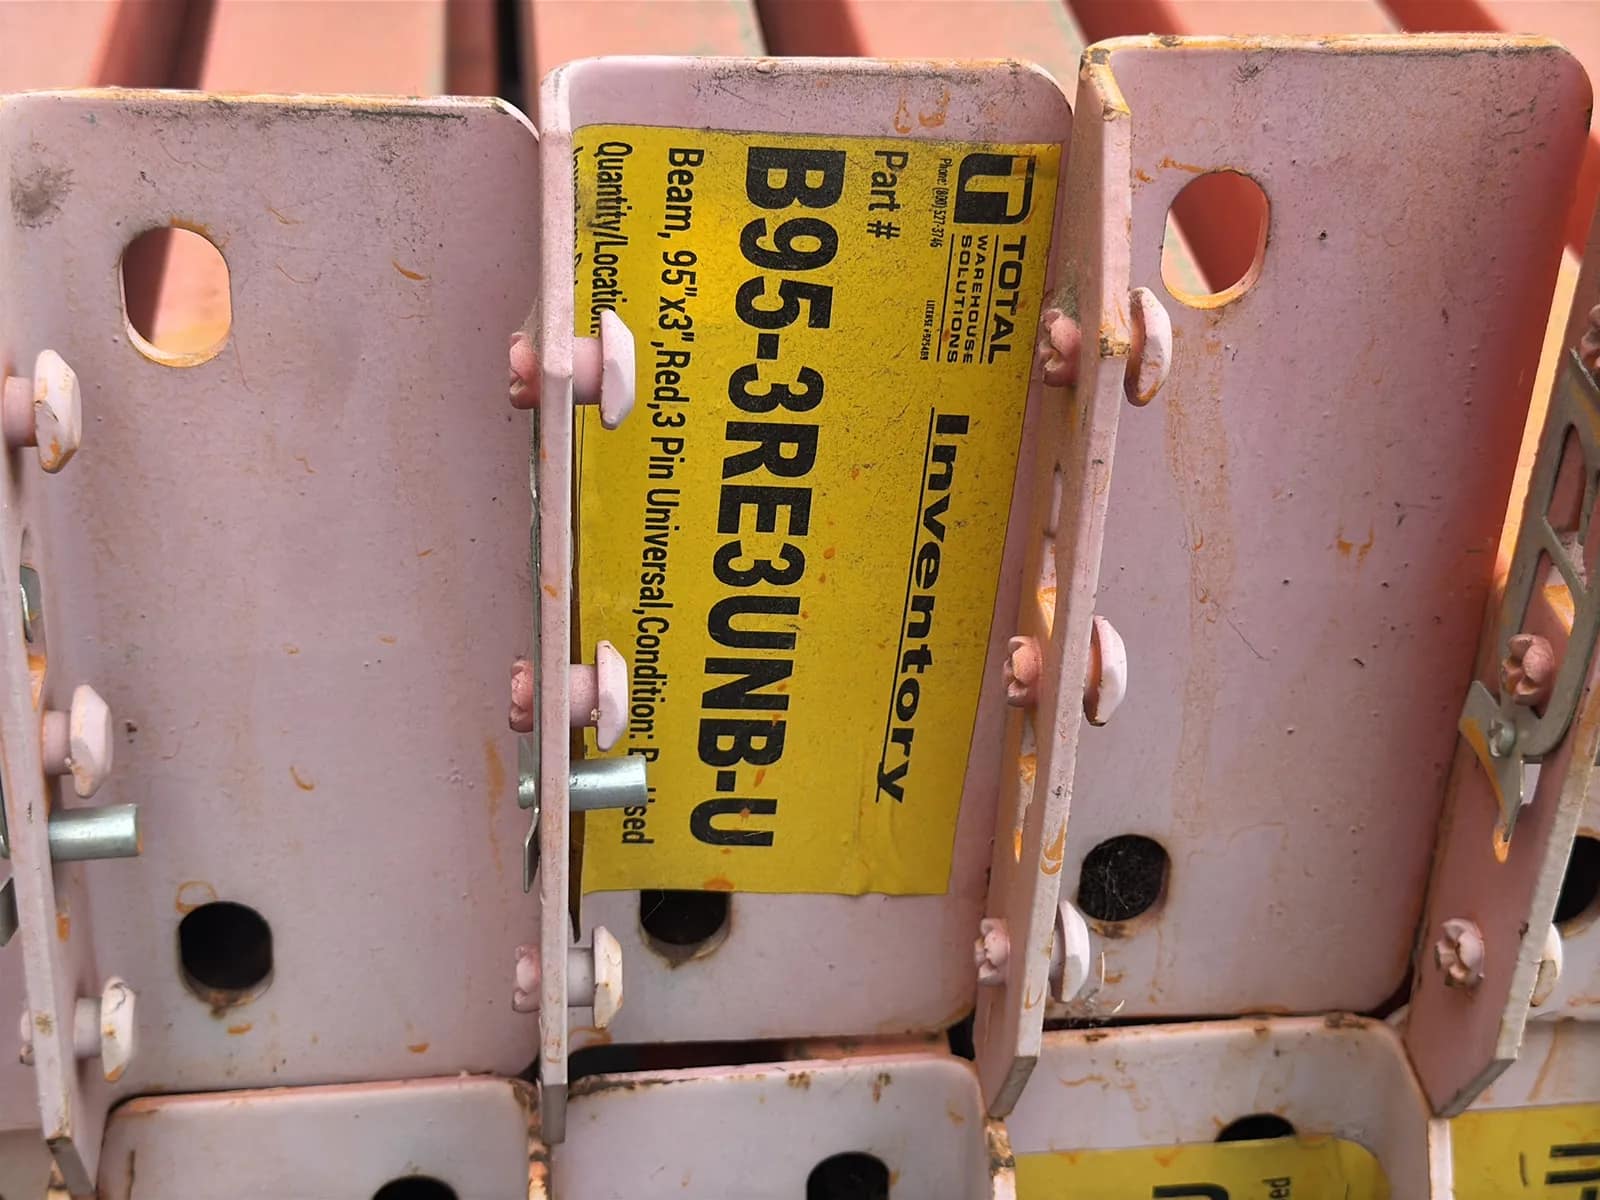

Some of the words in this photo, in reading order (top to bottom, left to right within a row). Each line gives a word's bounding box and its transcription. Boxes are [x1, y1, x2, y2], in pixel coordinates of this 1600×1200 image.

[657, 147, 705, 239] Beam,
[868, 150, 909, 212] Part
[938, 157, 952, 186] Phone:
[866, 219, 901, 240] #
[923, 300, 935, 327] LICENSE
[946, 234, 973, 363] SOLUTIONS
[963, 234, 989, 363] WAREHOUSE
[988, 234, 1027, 364] TOTAL
[648, 436, 685, 480] Pin
[689, 146, 846, 848] B95-3RE3UNB-U
[629, 488, 681, 740] Universal,Condition:
[876, 413, 969, 804] Inventory
[622, 786, 656, 844] sed
